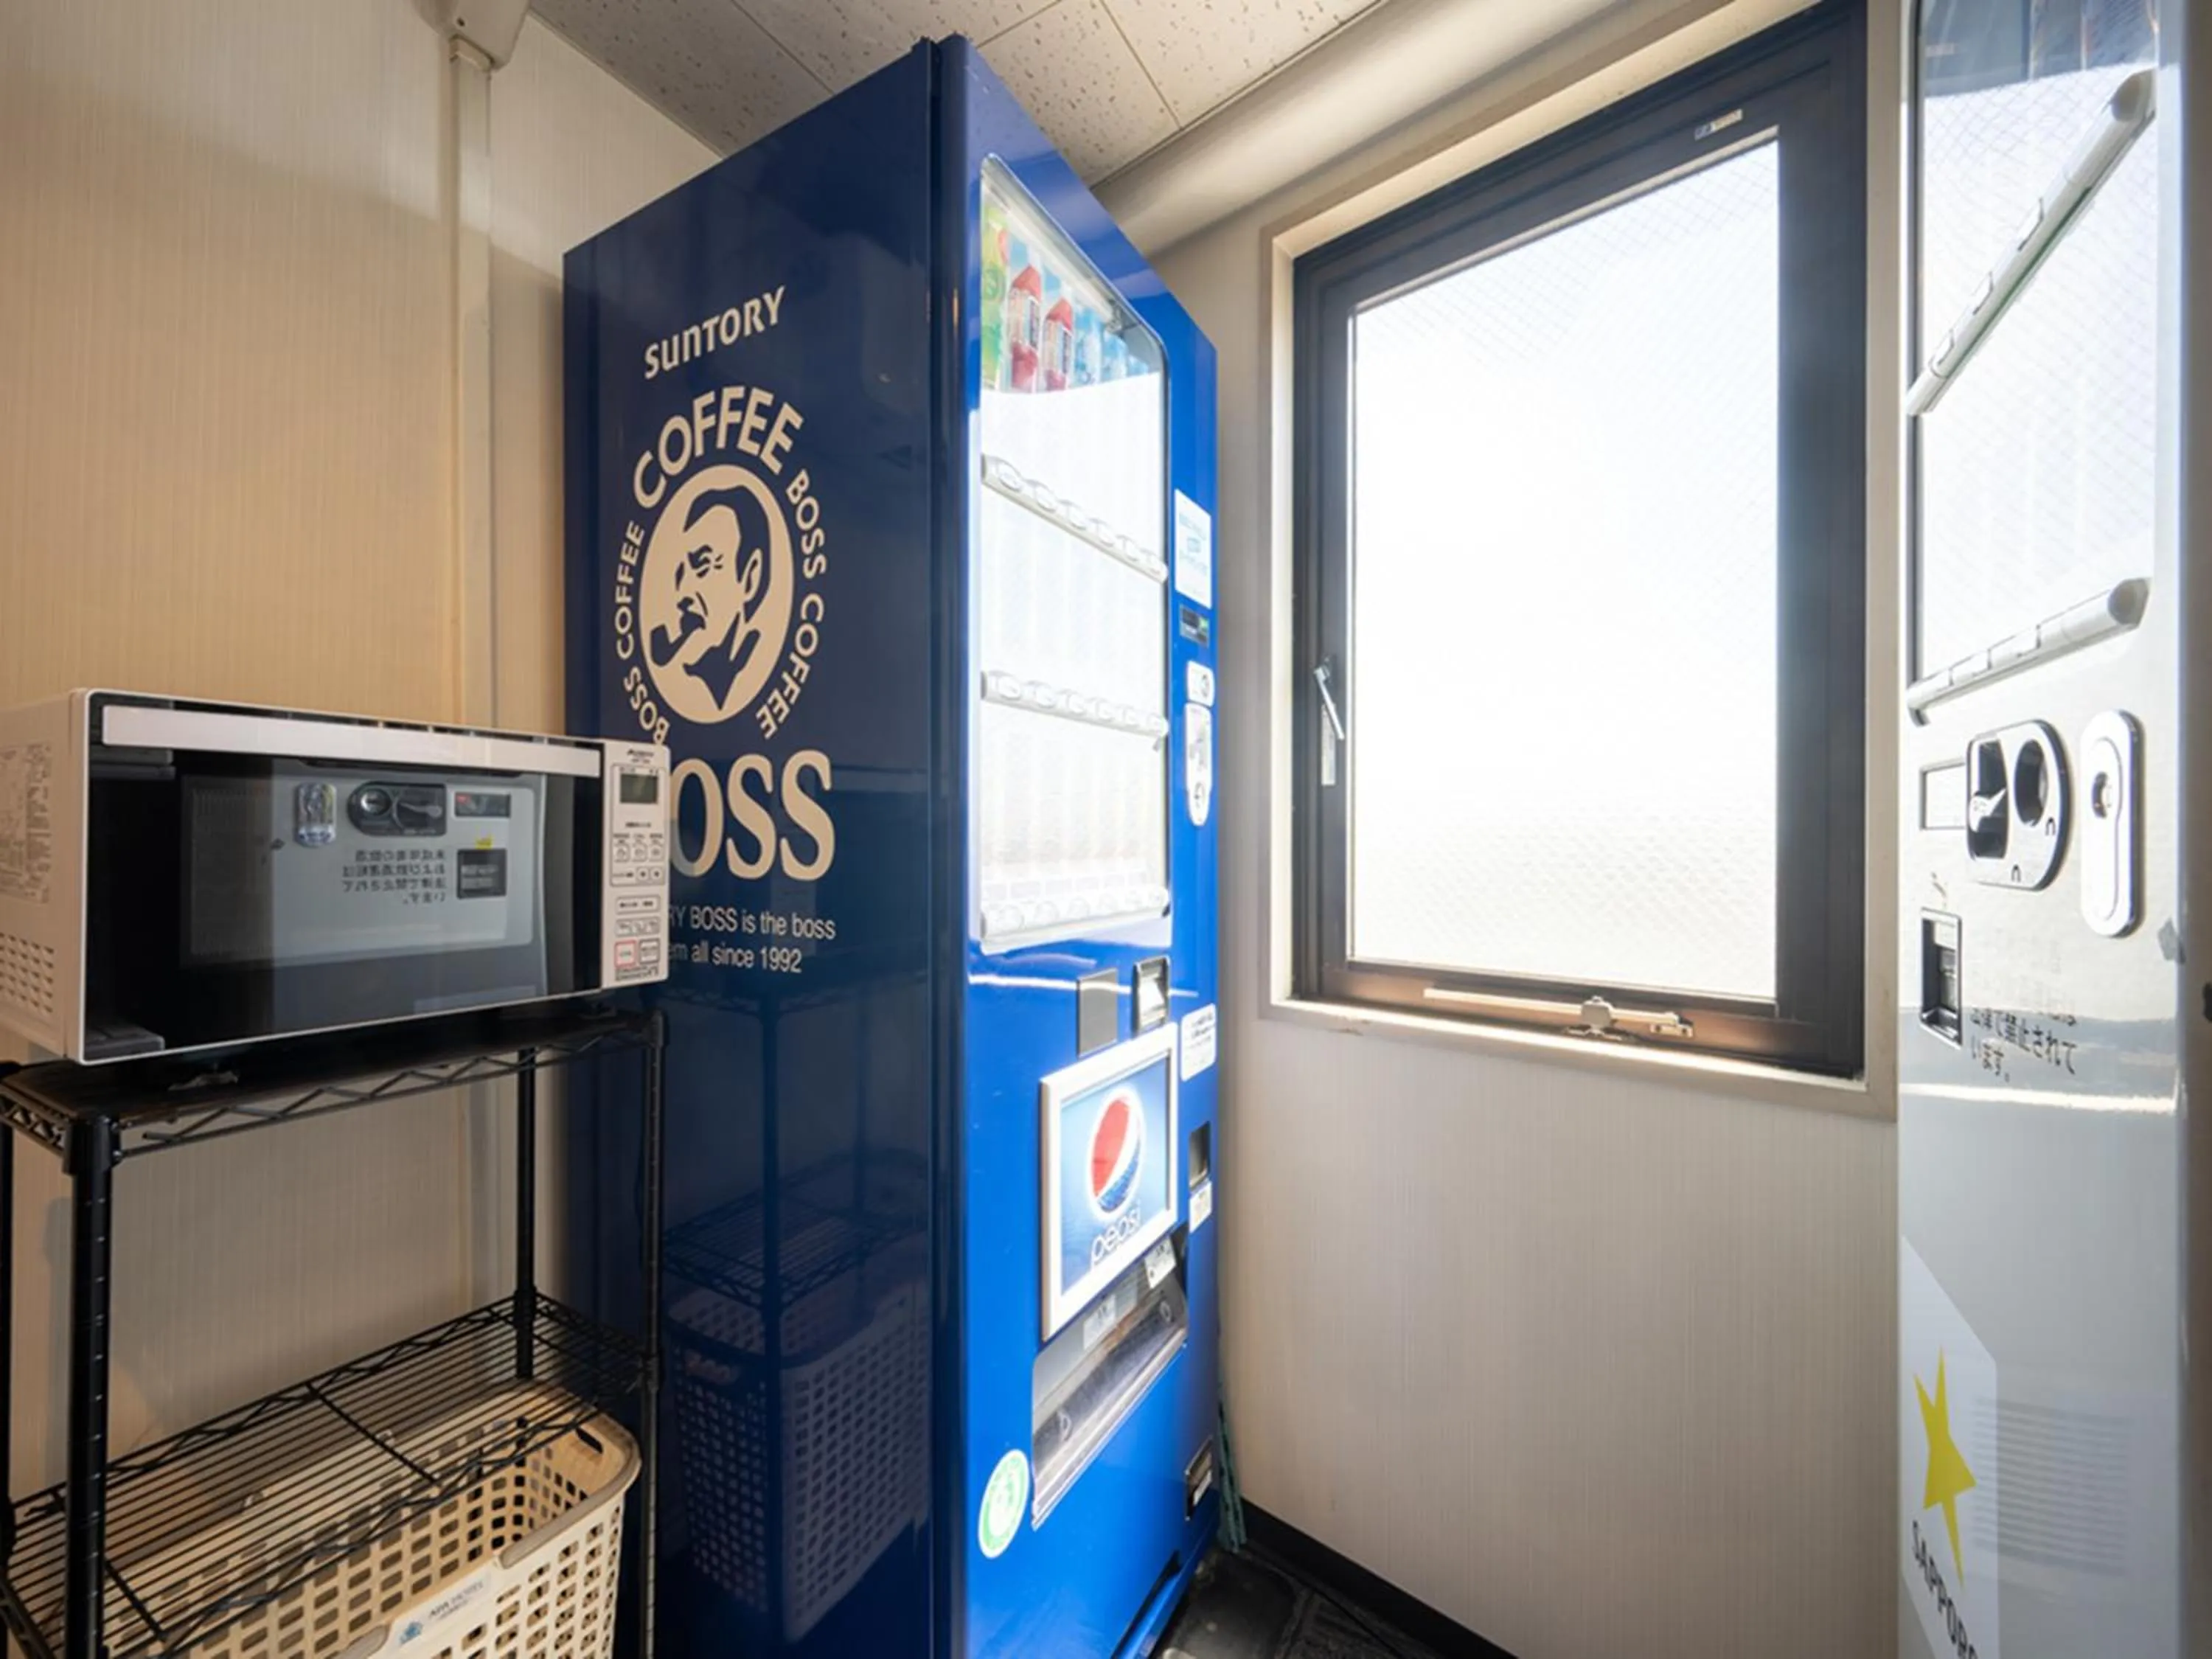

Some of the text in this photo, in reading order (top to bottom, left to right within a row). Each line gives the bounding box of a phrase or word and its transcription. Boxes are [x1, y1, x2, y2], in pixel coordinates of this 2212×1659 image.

[644, 285, 786, 380] SUNTORY
[633, 386, 804, 509] COFFEE
[614, 521, 646, 659] COFFEE
[755, 469, 827, 739] BOSS COFFEE
[623, 666, 670, 745] BOSS
[669, 749, 835, 881] OSS
[689, 905, 737, 932] BOSS
[741, 909, 757, 934] is
[759, 911, 787, 936] the
[791, 912, 836, 940] boss
[691, 939, 709, 963] all
[712, 941, 754, 968] since
[760, 945, 803, 973] 1992
[1091, 1198, 1141, 1270] pepsi
